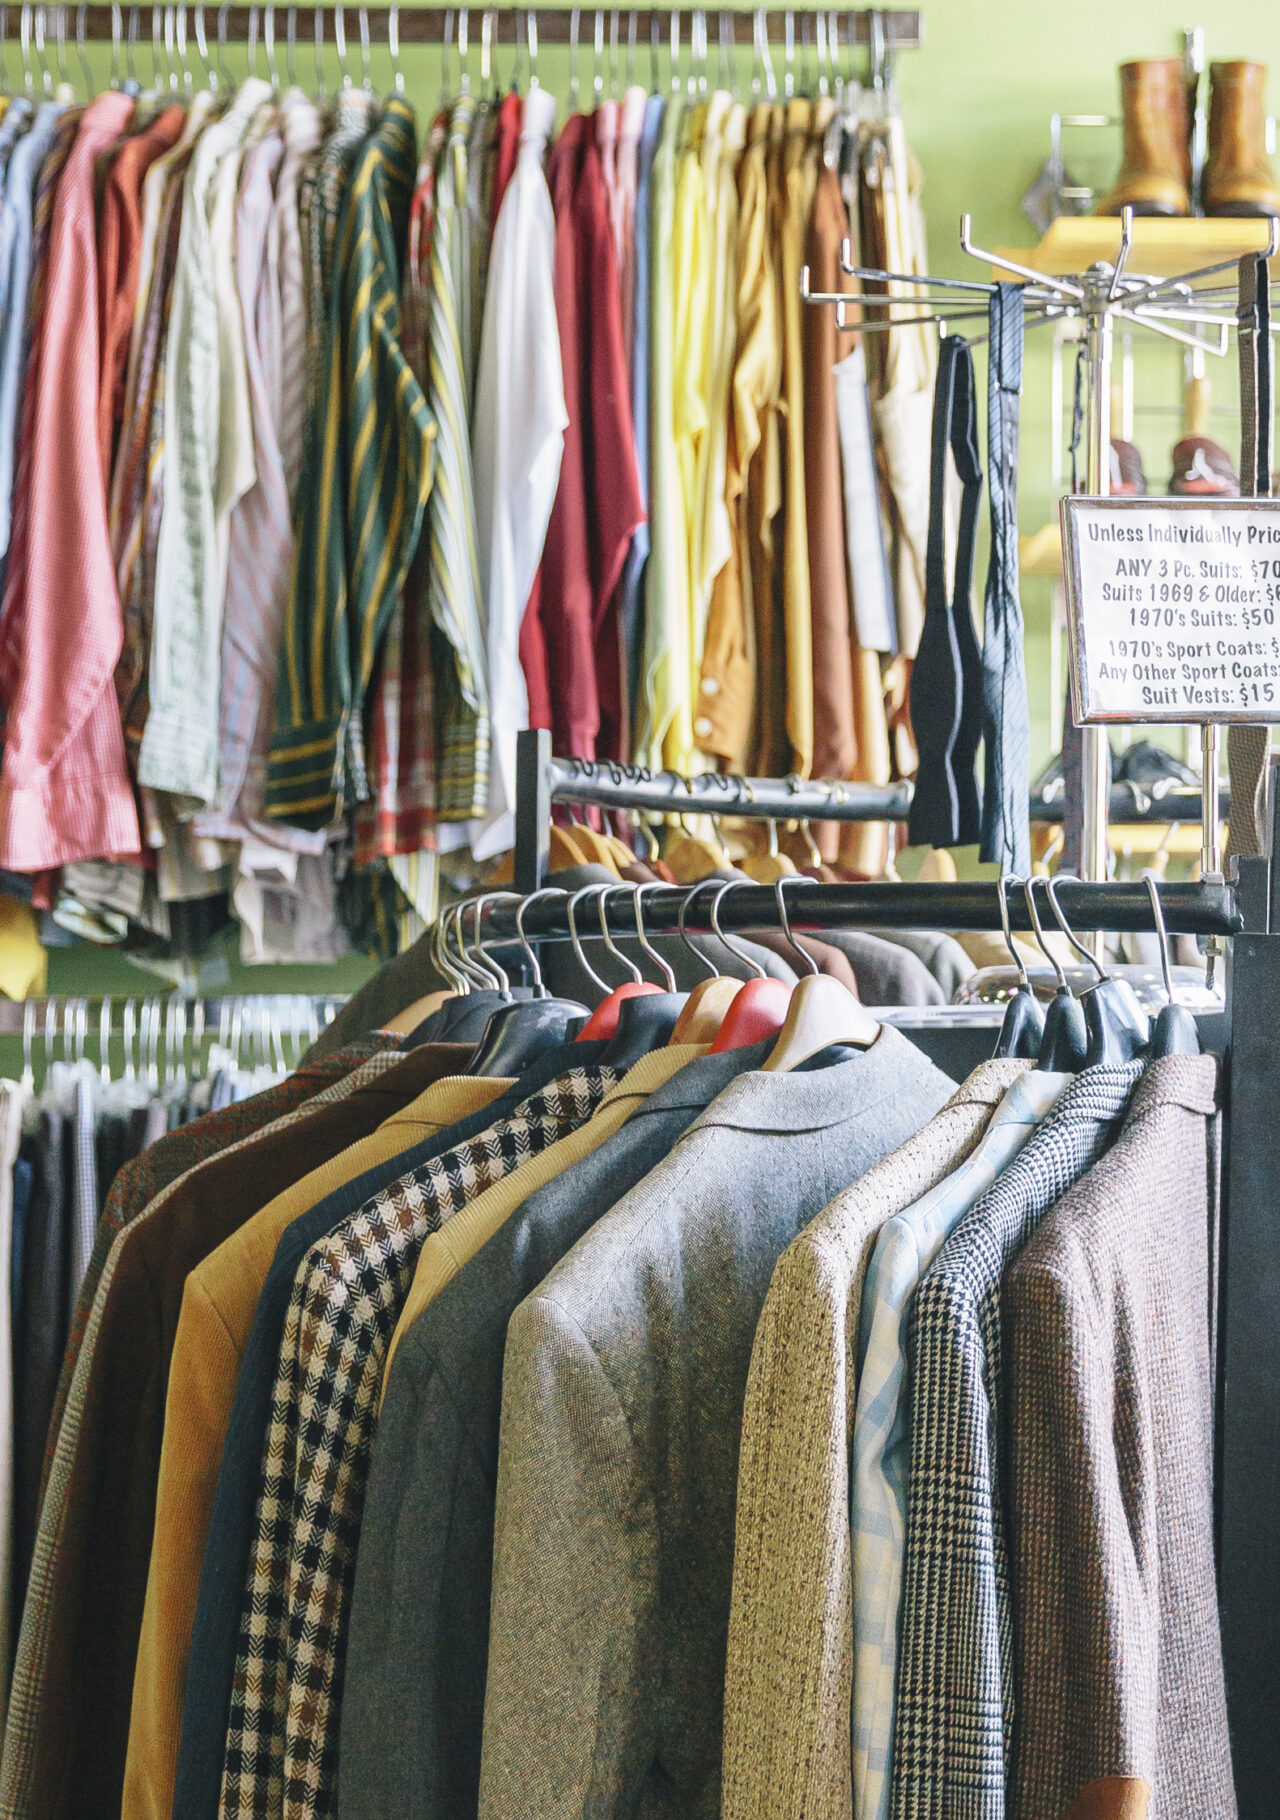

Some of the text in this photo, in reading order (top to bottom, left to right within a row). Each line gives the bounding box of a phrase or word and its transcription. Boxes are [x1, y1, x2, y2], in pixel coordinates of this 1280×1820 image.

[1088, 523, 1144, 543] Unless
[1148, 524, 1242, 547] Individually
[1115, 559, 1153, 578] ANY
[1158, 560, 1169, 577] 3
[1174, 560, 1195, 578] Pc.
[1200, 561, 1243, 578] Suits:
[1102, 583, 1143, 602] Suits
[1150, 583, 1193, 602] 1969
[1199, 585, 1210, 602] &
[1215, 585, 1262, 603] Older:
[1129, 608, 1275, 629] 1970's Suits: $50
[1109, 640, 1163, 658] 1970's
[1167, 641, 1211, 661] Sport
[1217, 640, 1267, 657] Coats:
[1099, 663, 1127, 682] Any
[1132, 663, 1176, 680] Other
[1182, 663, 1227, 683] Sport
[1142, 683, 1275, 707] Suit Vests: $15
